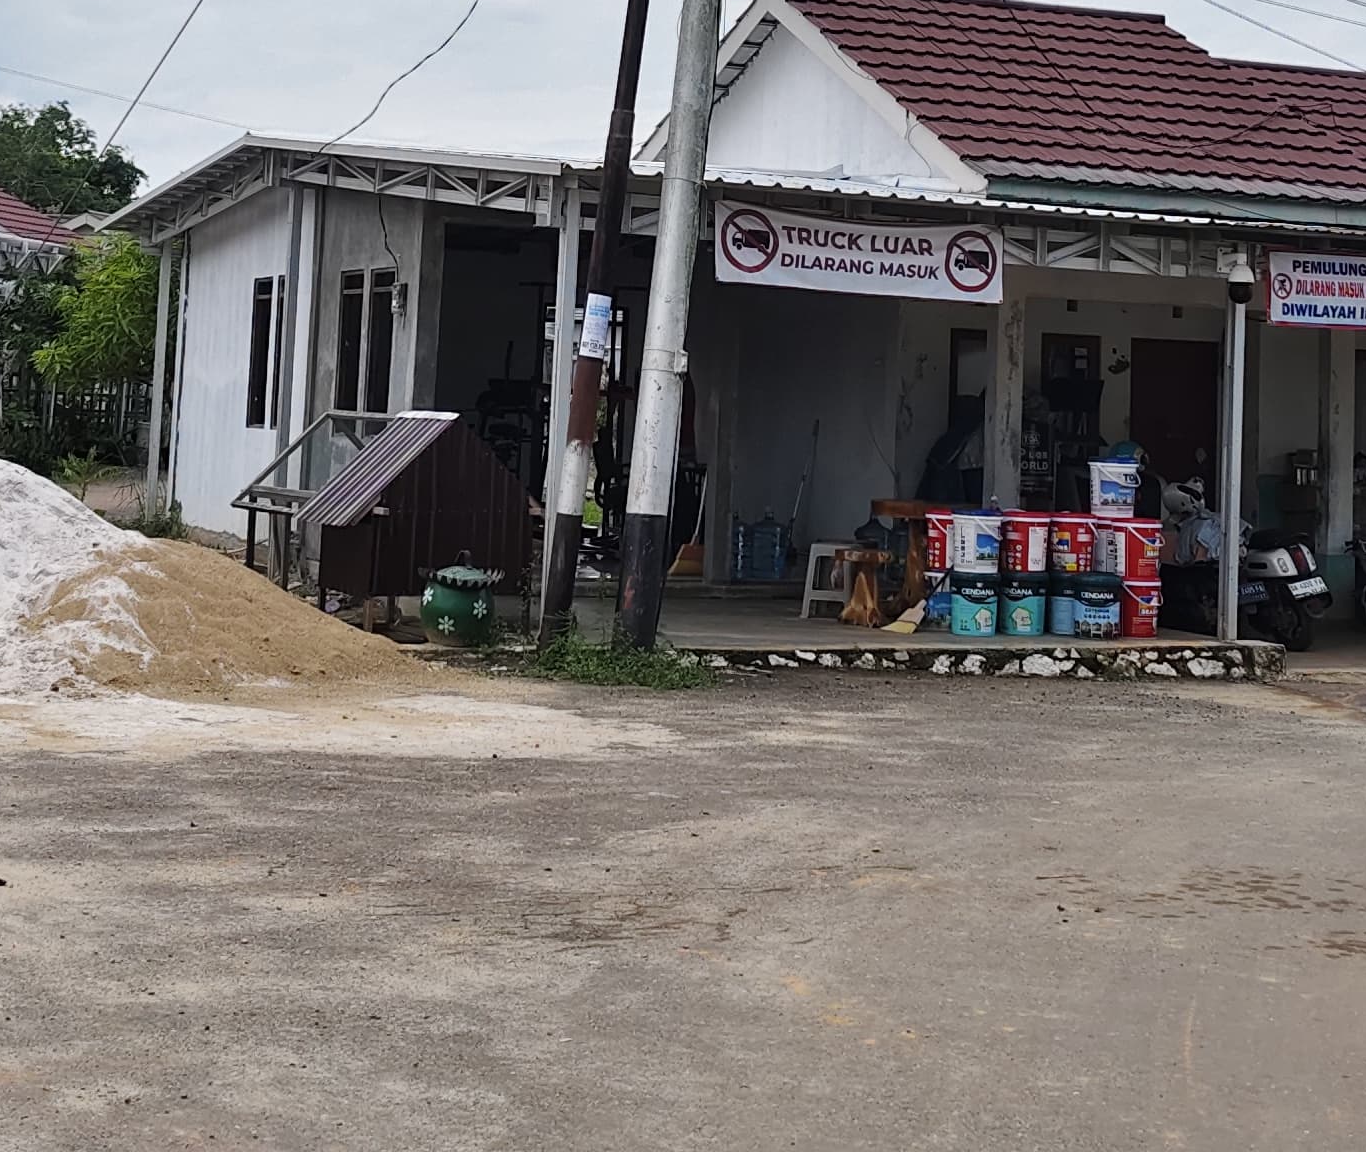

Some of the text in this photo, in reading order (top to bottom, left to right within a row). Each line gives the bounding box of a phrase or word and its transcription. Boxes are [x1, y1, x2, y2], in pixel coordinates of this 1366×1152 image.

[781, 225, 935, 256] TRUCK LUAR
[780, 253, 939, 281] DILARANG MASUK
[1295, 279, 1365, 298] DILARANG MASUK
[1281, 303, 1356, 319] DIWILAYAH
[1080, 591, 1115, 600] CENDANA
